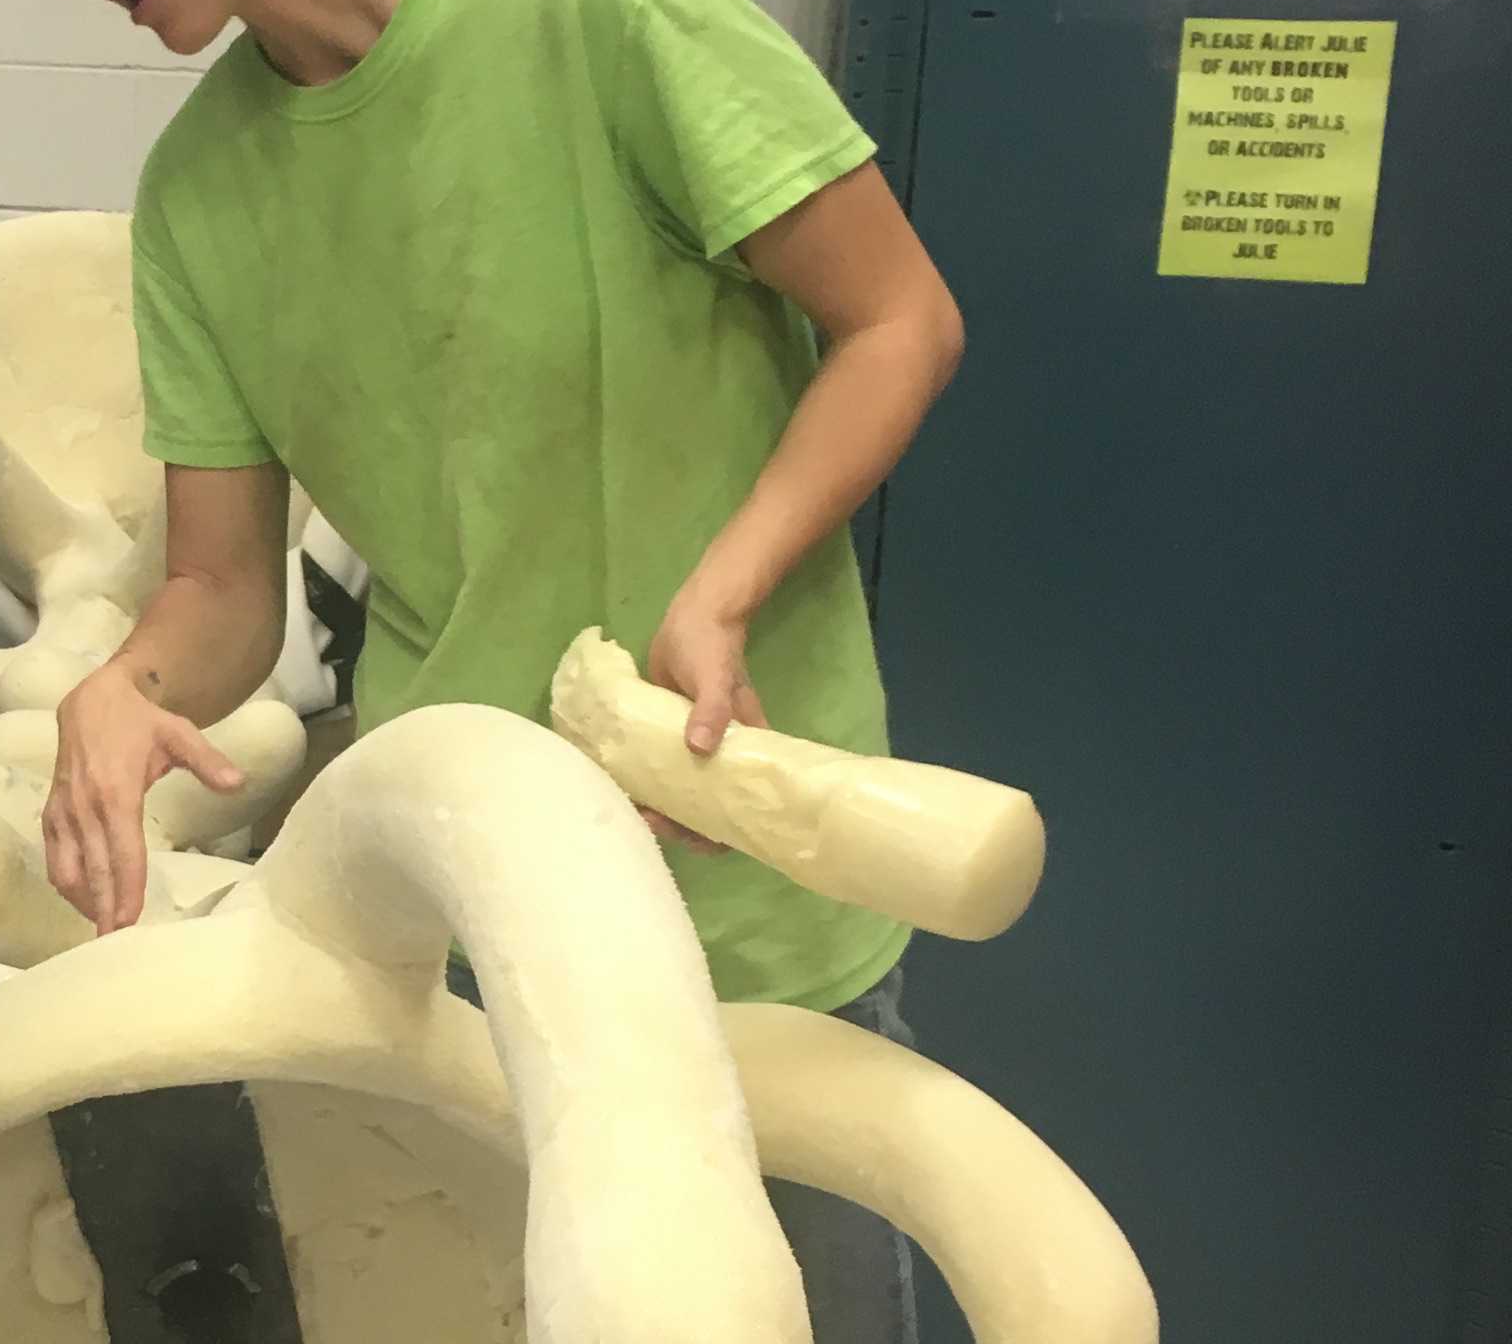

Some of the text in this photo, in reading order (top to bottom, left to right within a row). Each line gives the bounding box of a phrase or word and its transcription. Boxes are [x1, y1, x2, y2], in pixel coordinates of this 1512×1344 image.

[1190, 32, 1368, 52] PLEASE ALERT JULIE
[1201, 59, 1349, 79] OF ANY BROKEN
[1233, 86, 1314, 103] TOOLS OR
[1208, 140, 1325, 158] OR ACCIDENTS
[1205, 190, 1341, 210] PLEASE TURN IN
[1181, 215, 1334, 236] BROKEN TOOLS TO
[1232, 243, 1278, 259] JULIE
